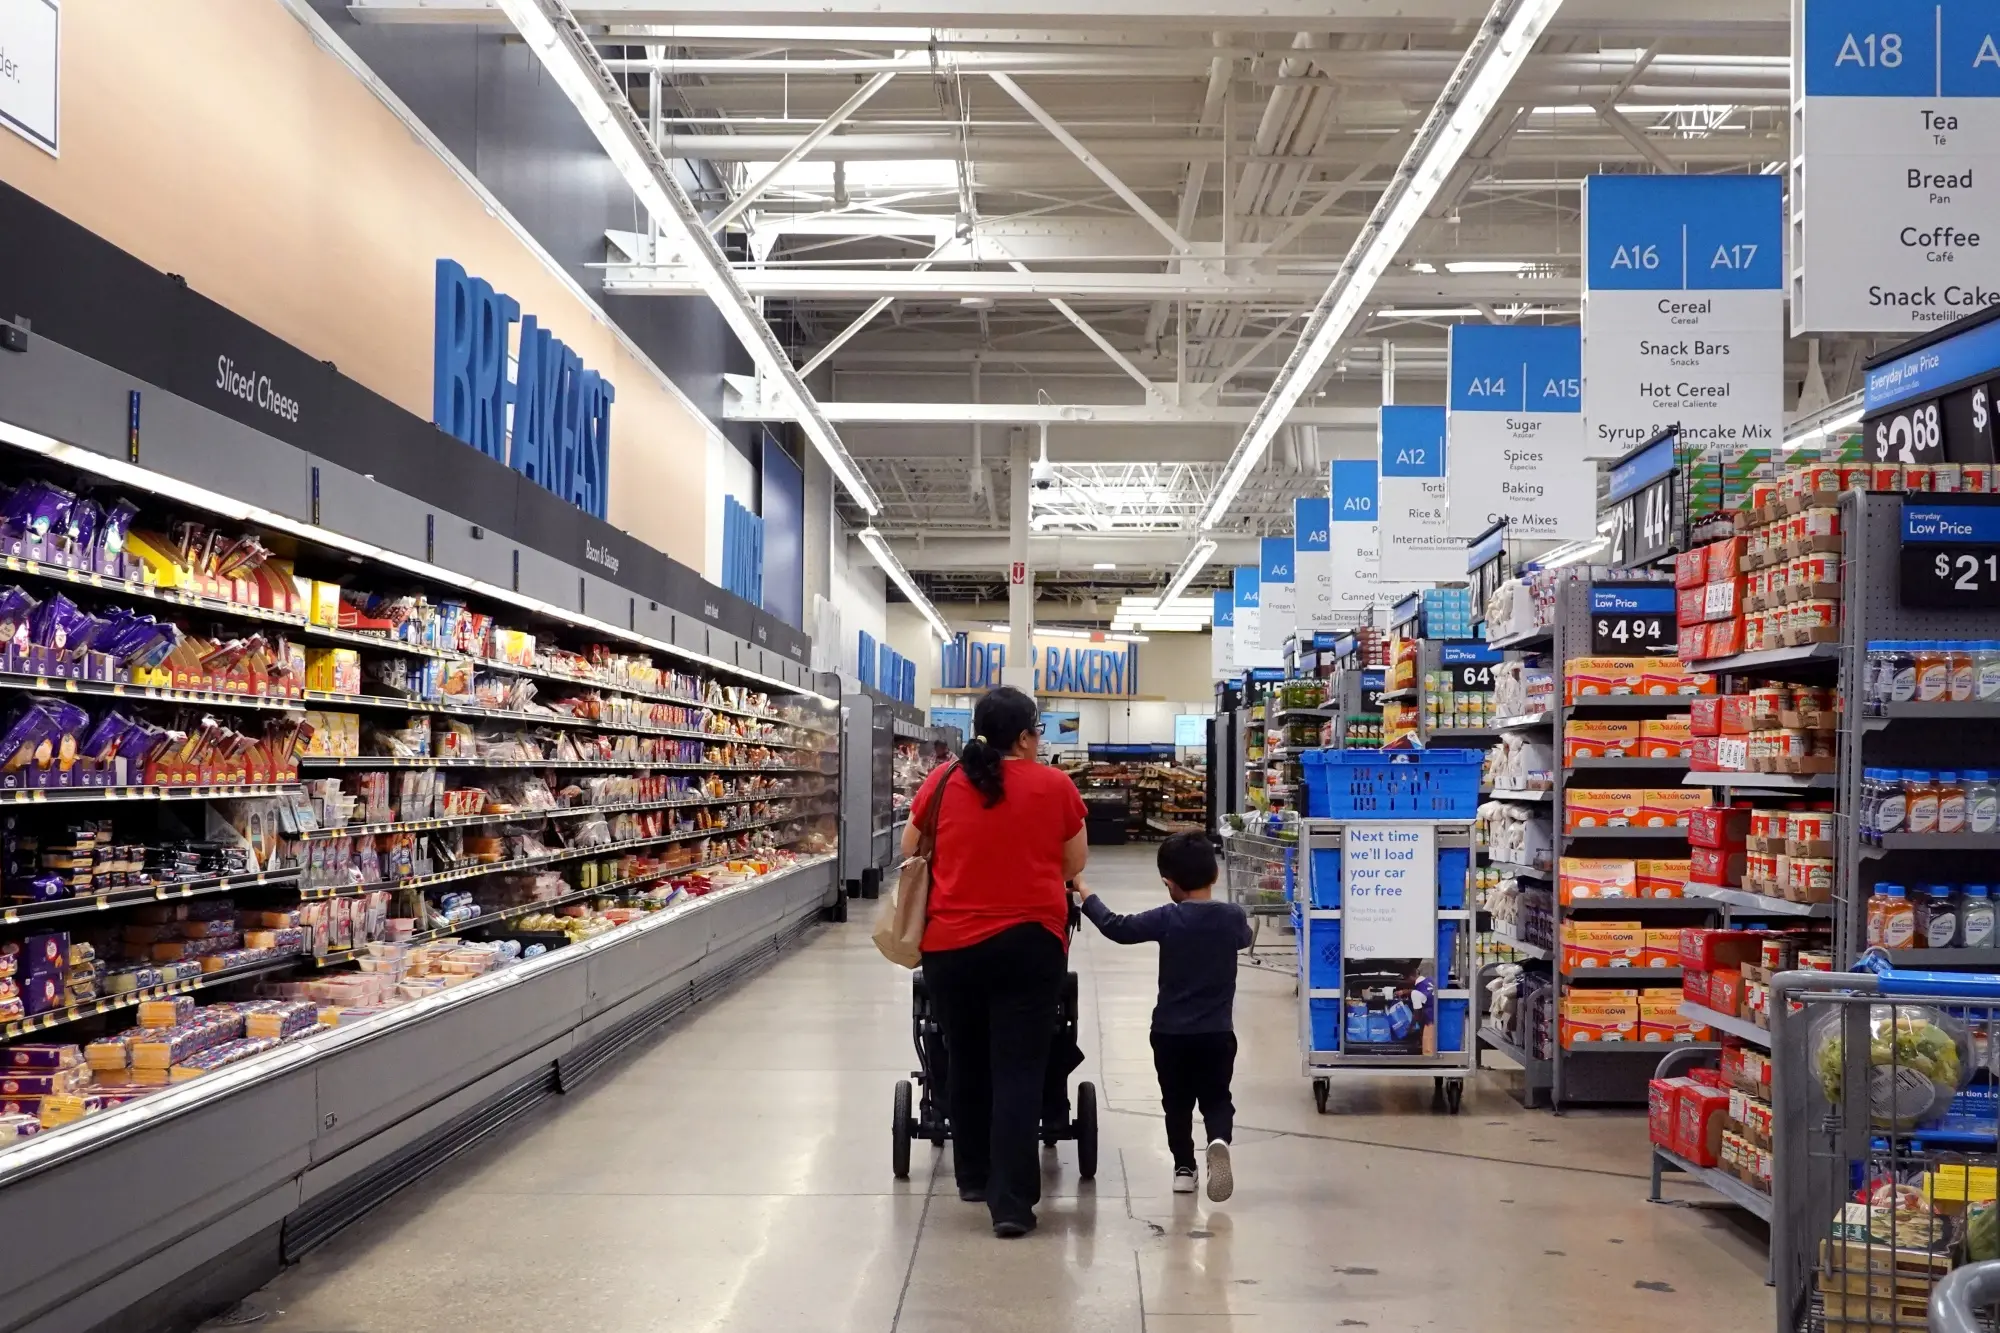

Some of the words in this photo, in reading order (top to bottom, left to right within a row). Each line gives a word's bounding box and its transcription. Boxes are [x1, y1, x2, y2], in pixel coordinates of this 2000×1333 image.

[1835, 33, 1903, 68] A18
[1920, 110, 1958, 131] Tea
[1933, 134, 1947, 146] Té
[1907, 168, 1973, 189] Bread
[1929, 193, 1951, 205] Pan
[1900, 226, 1980, 248] Coffee
[1610, 244, 1660, 270] A16
[1710, 244, 1758, 270] A17
[1926, 251, 1954, 263] Café
[1869, 286, 1936, 306] Snack
[1657, 298, 1712, 315] Cereal
[1670, 316, 1699, 325] Cereal
[1640, 341, 1688, 356] Snack
[1694, 341, 1730, 356] Bars
[1670, 357, 1700, 367] Snacks
[1871, 369, 1902, 390] Everyday
[1903, 363, 1919, 378] Low
[1920, 353, 1940, 370] Price
[216, 354, 256, 403] Sliced
[257, 375, 299, 423] Cheese
[1467, 376, 1506, 397] A14
[1543, 377, 1581, 398] A15
[1640, 382, 1671, 398] Hot
[1676, 382, 1731, 398] Cereal
[1652, 400, 1680, 408] Cereal
[1682, 400, 1718, 408] Caliente
[1506, 418, 1543, 434] Sugar
[1598, 423, 1646, 443] Syrup
[1679, 424, 1738, 439] ancake
[1742, 424, 1773, 439] Mix
[1710, 441, 1749, 450] Pancakes
[1395, 448, 1426, 465] A12
[1503, 450, 1544, 466] Spices
[1509, 463, 1537, 472] Especias
[1502, 481, 1545, 497] Baking
[1343, 496, 1371, 511] A10
[1408, 508, 1431, 519] Rice
[1433, 508, 1442, 519] &
[1522, 513, 1559, 526] Mixes
[1910, 512, 1941, 521] Everyday
[1909, 521, 1936, 534] Low
[1939, 521, 1973, 535] Price
[1308, 529, 1328, 543] A8
[1357, 548, 1374, 557] Box
[1271, 564, 1288, 576] A6
[1243, 591, 1259, 601] A4
[1341, 592, 1375, 601] Canned
[1268, 602, 1291, 610] Frozen
[1595, 599, 1613, 608] Low
[1615, 599, 1638, 608] Price
[1311, 613, 1333, 621] Salad
[1445, 652, 1459, 660] Low
[1046, 646, 1128, 695] BAKERY
[1591, 660, 1614, 669] Sazón
[1463, 667, 1490, 686] 64
[1584, 722, 1607, 732] Sazón
[1587, 791, 1611, 800] Sazón
[1656, 791, 1680, 800] Sazón
[1350, 830, 1384, 842] Next
[1388, 829, 1419, 842] time
[1350, 847, 1381, 860] we'll
[1385, 847, 1414, 860] load
[1350, 869, 1381, 881] your
[1384, 869, 1406, 878] car
[1350, 884, 1371, 897] for
[1375, 884, 1403, 897] free
[1589, 932, 1613, 941] Sazón
[1349, 944, 1376, 953] Pickup
[1582, 1005, 1605, 1015] Sazón
